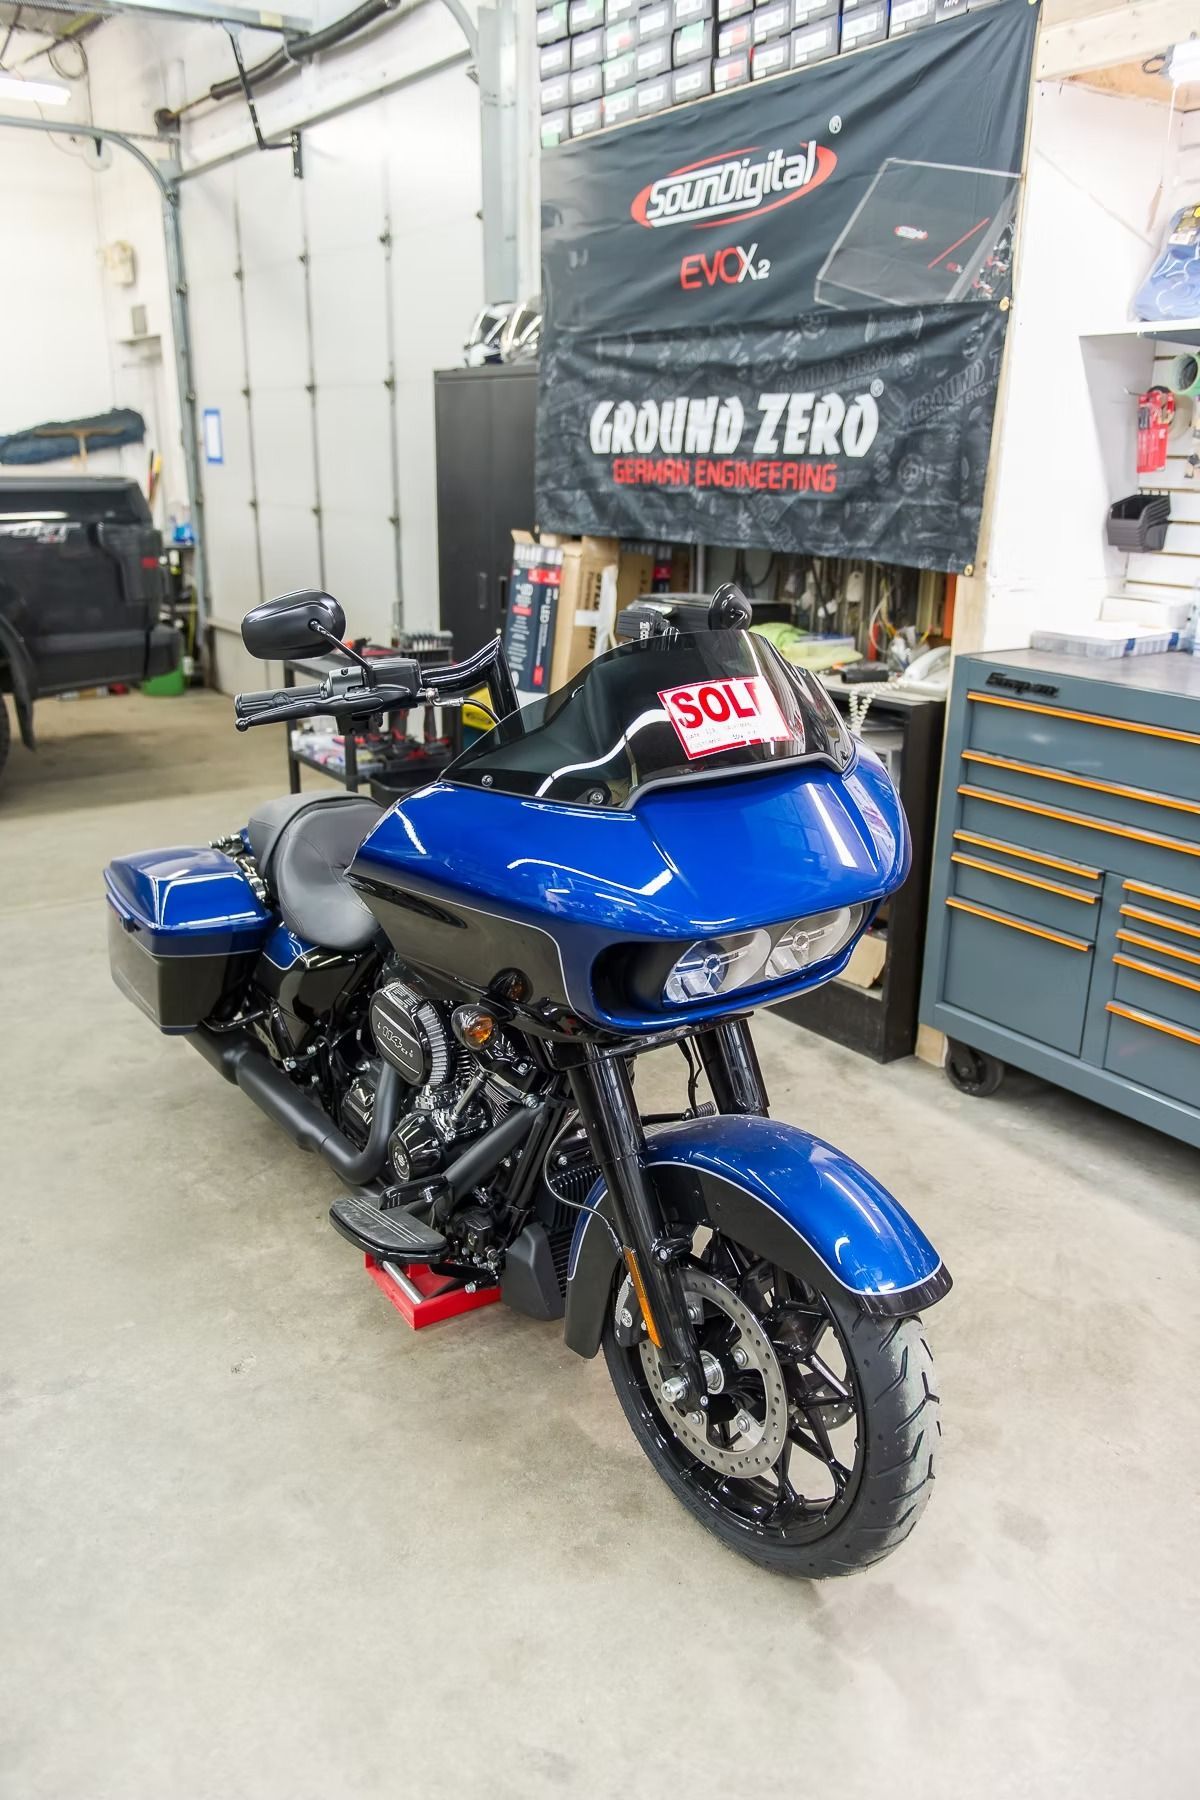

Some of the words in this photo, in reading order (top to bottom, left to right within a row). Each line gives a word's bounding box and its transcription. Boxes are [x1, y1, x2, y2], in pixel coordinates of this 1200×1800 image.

[646, 140, 817, 227] SounDigital
[589, 396, 745, 455] GROUND
[752, 392, 880, 458] ZERO
[612, 458, 690, 486] GERMAN
[694, 459, 838, 493] ENGINEERING
[383, 1025, 403, 1048] 114
